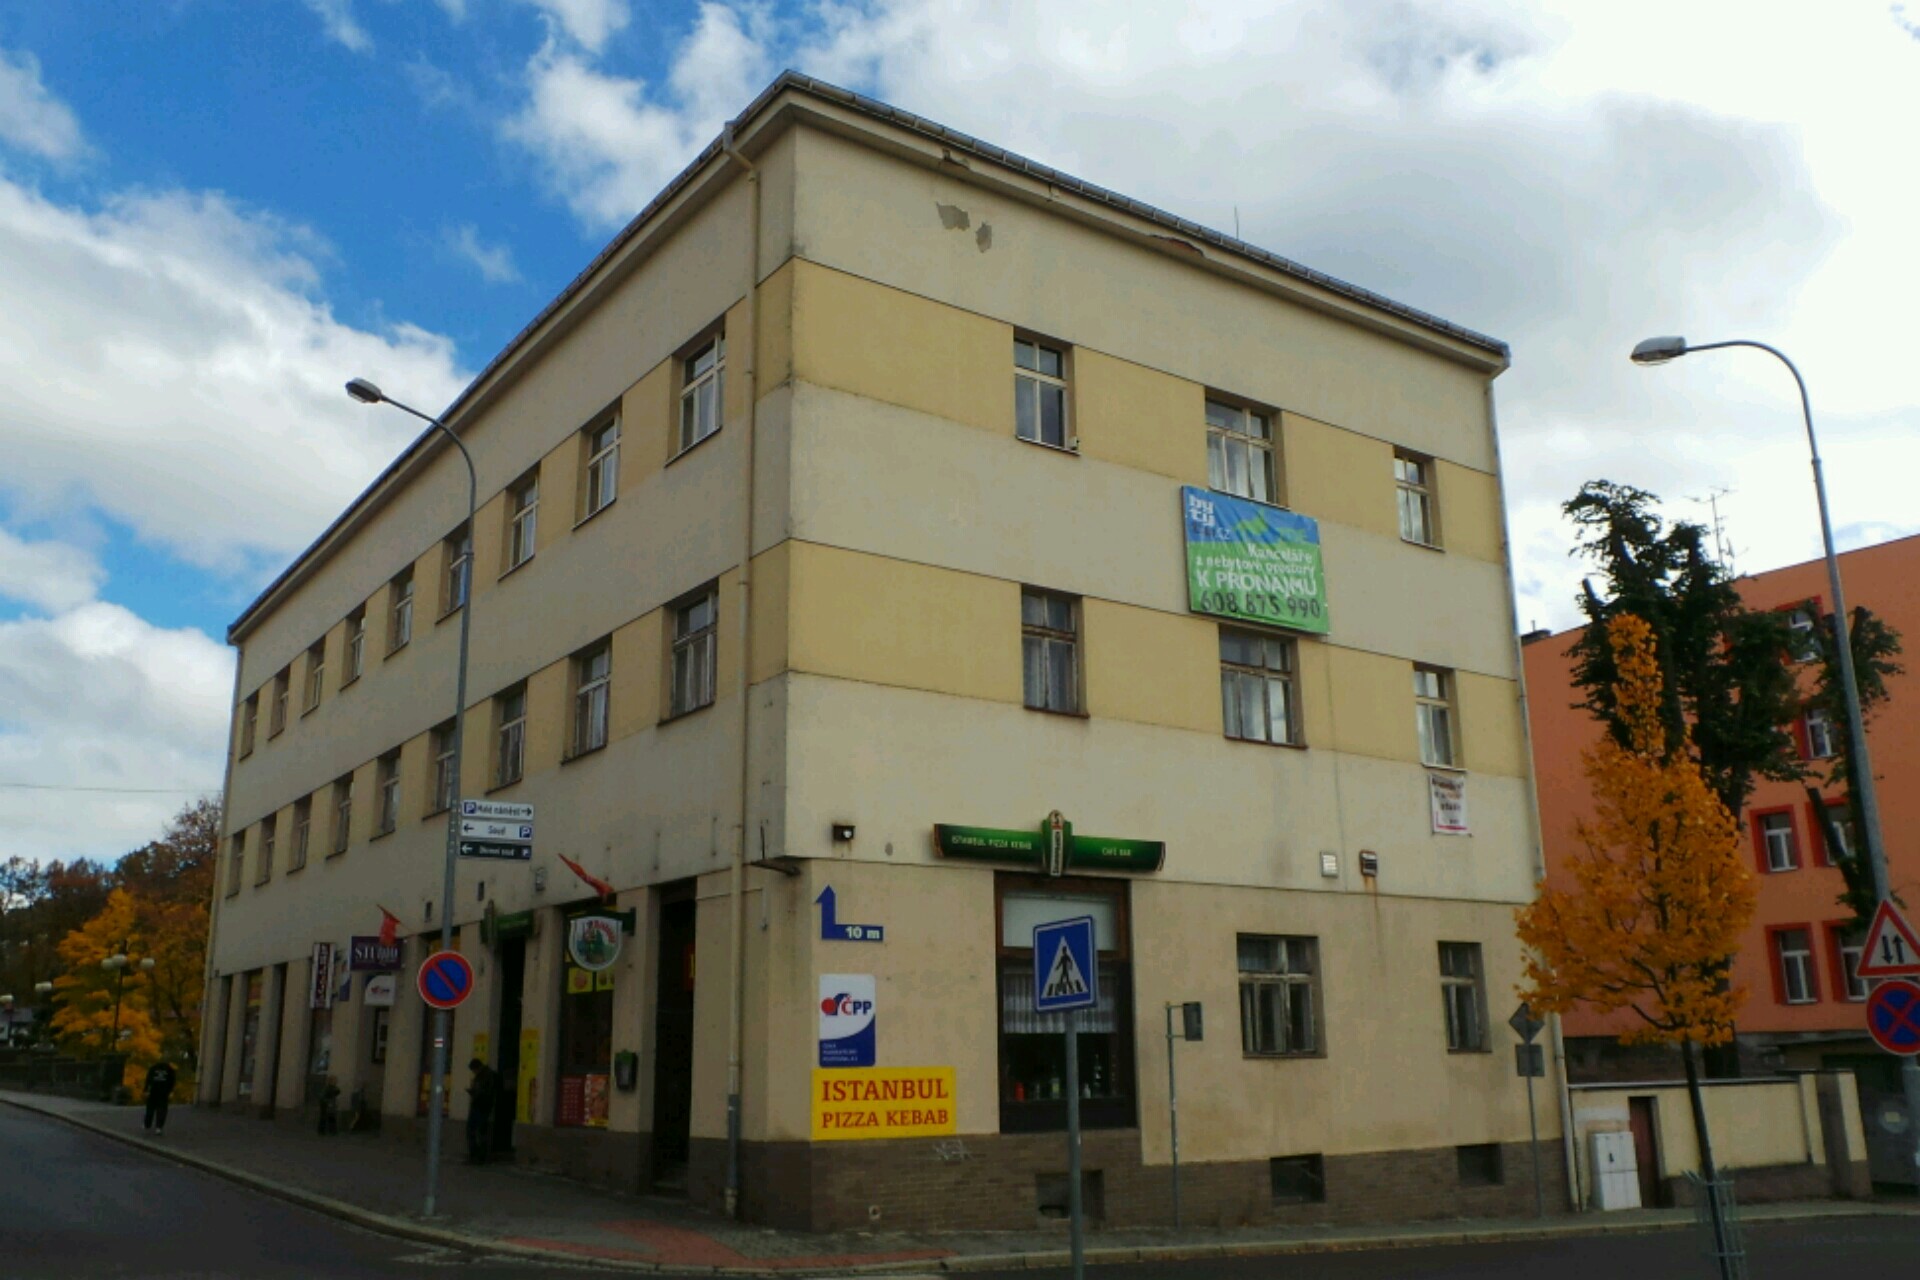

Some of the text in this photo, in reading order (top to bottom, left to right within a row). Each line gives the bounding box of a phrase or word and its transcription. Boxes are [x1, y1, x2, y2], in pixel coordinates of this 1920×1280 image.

[1196, 570, 1210, 588] K
[1201, 591, 1321, 619] 608 675 990
[989, 839, 1008, 848] PIZZA
[1011, 841, 1032, 850] KEBAB
[845, 926, 880, 939] 10 m
[841, 995, 873, 1016] ČPP
[821, 1078, 949, 1102] ISTANBUL
[821, 1109, 949, 1129] PIZZA KEBAB
